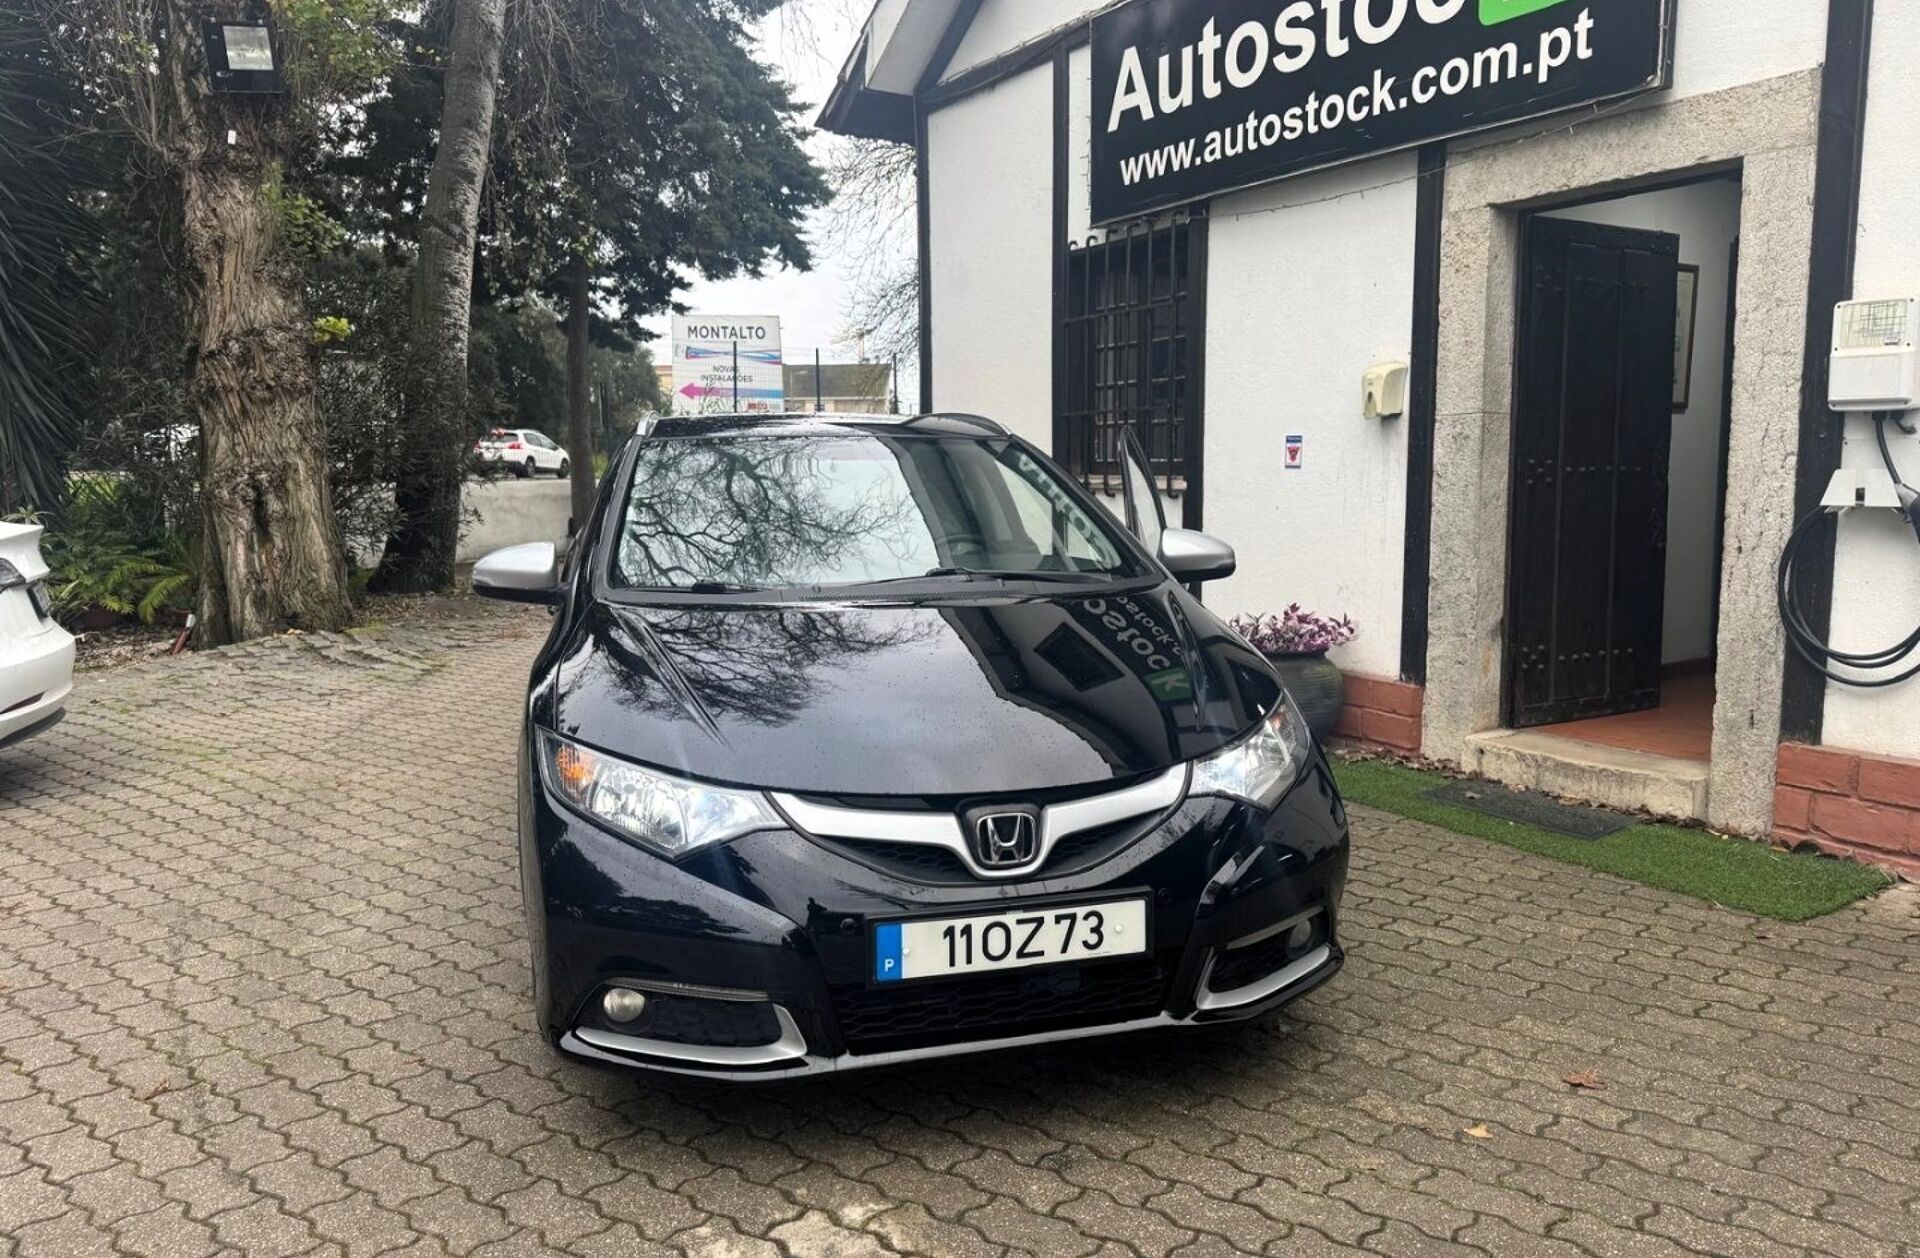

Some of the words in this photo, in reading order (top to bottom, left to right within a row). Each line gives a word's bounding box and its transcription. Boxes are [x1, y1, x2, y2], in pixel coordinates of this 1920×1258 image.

[1119, 7, 1595, 186] www.autostock.com.pt
[687, 325, 766, 339] MONTALTO
[884, 959, 894, 972] P
